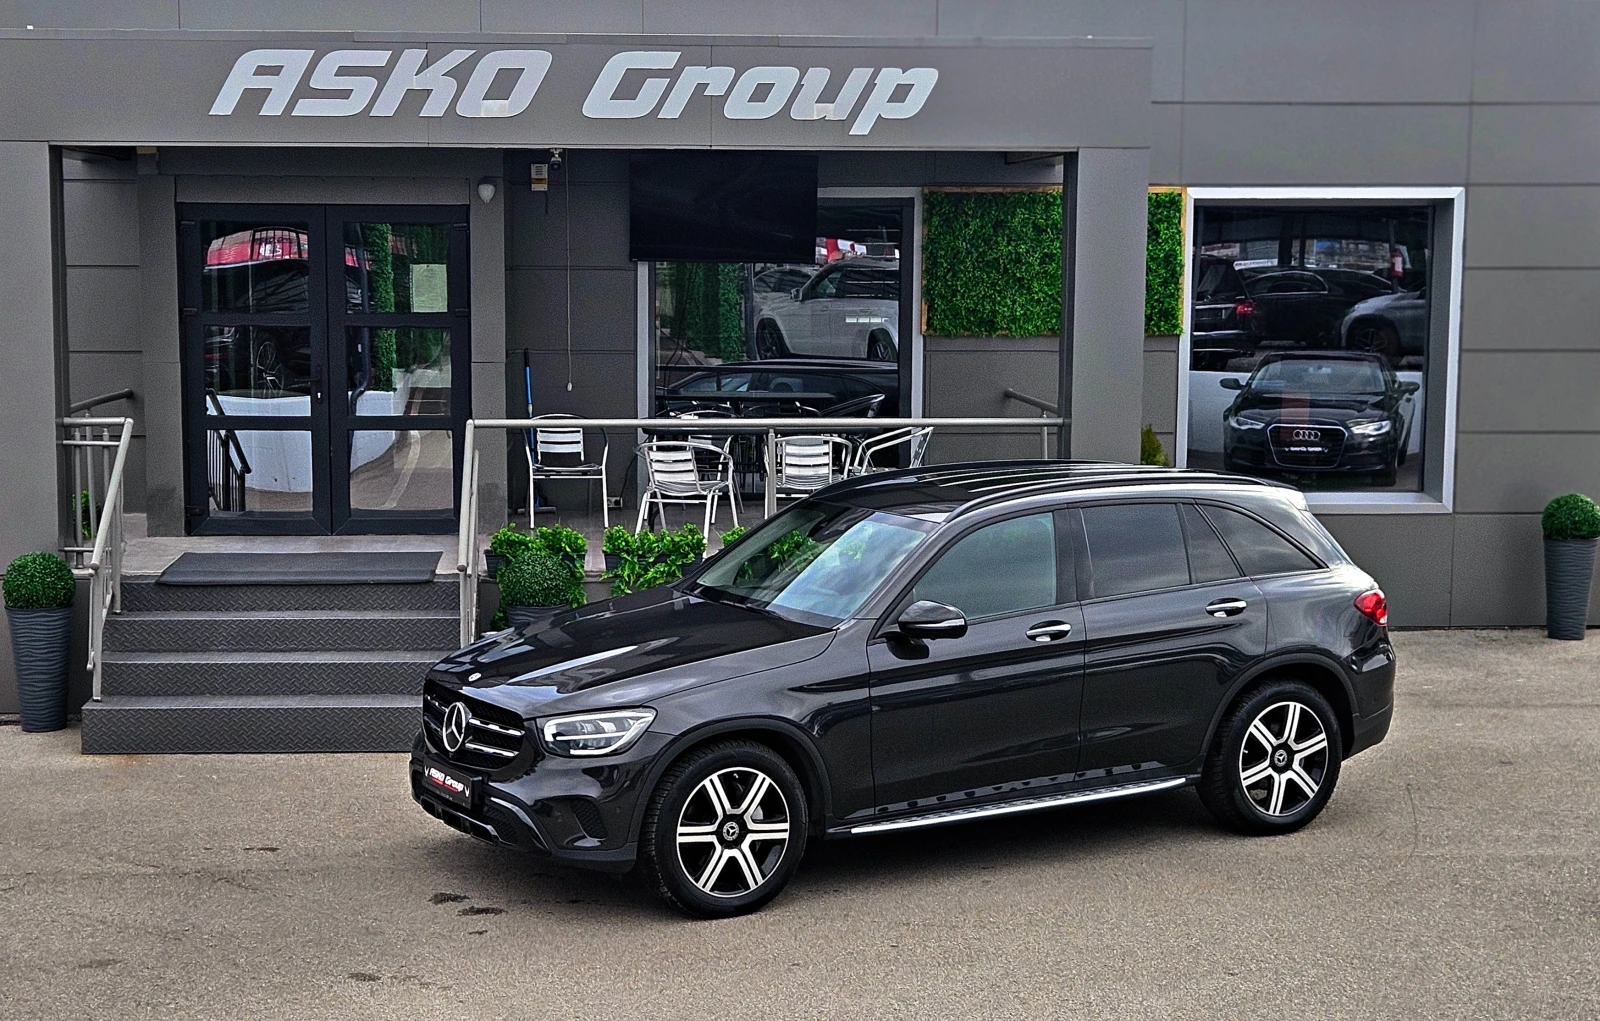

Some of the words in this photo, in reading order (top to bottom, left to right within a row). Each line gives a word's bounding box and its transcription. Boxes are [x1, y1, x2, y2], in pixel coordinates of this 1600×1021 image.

[209, 49, 552, 117] ASKO
[582, 51, 938, 135] Group
[445, 775, 464, 792] Group
